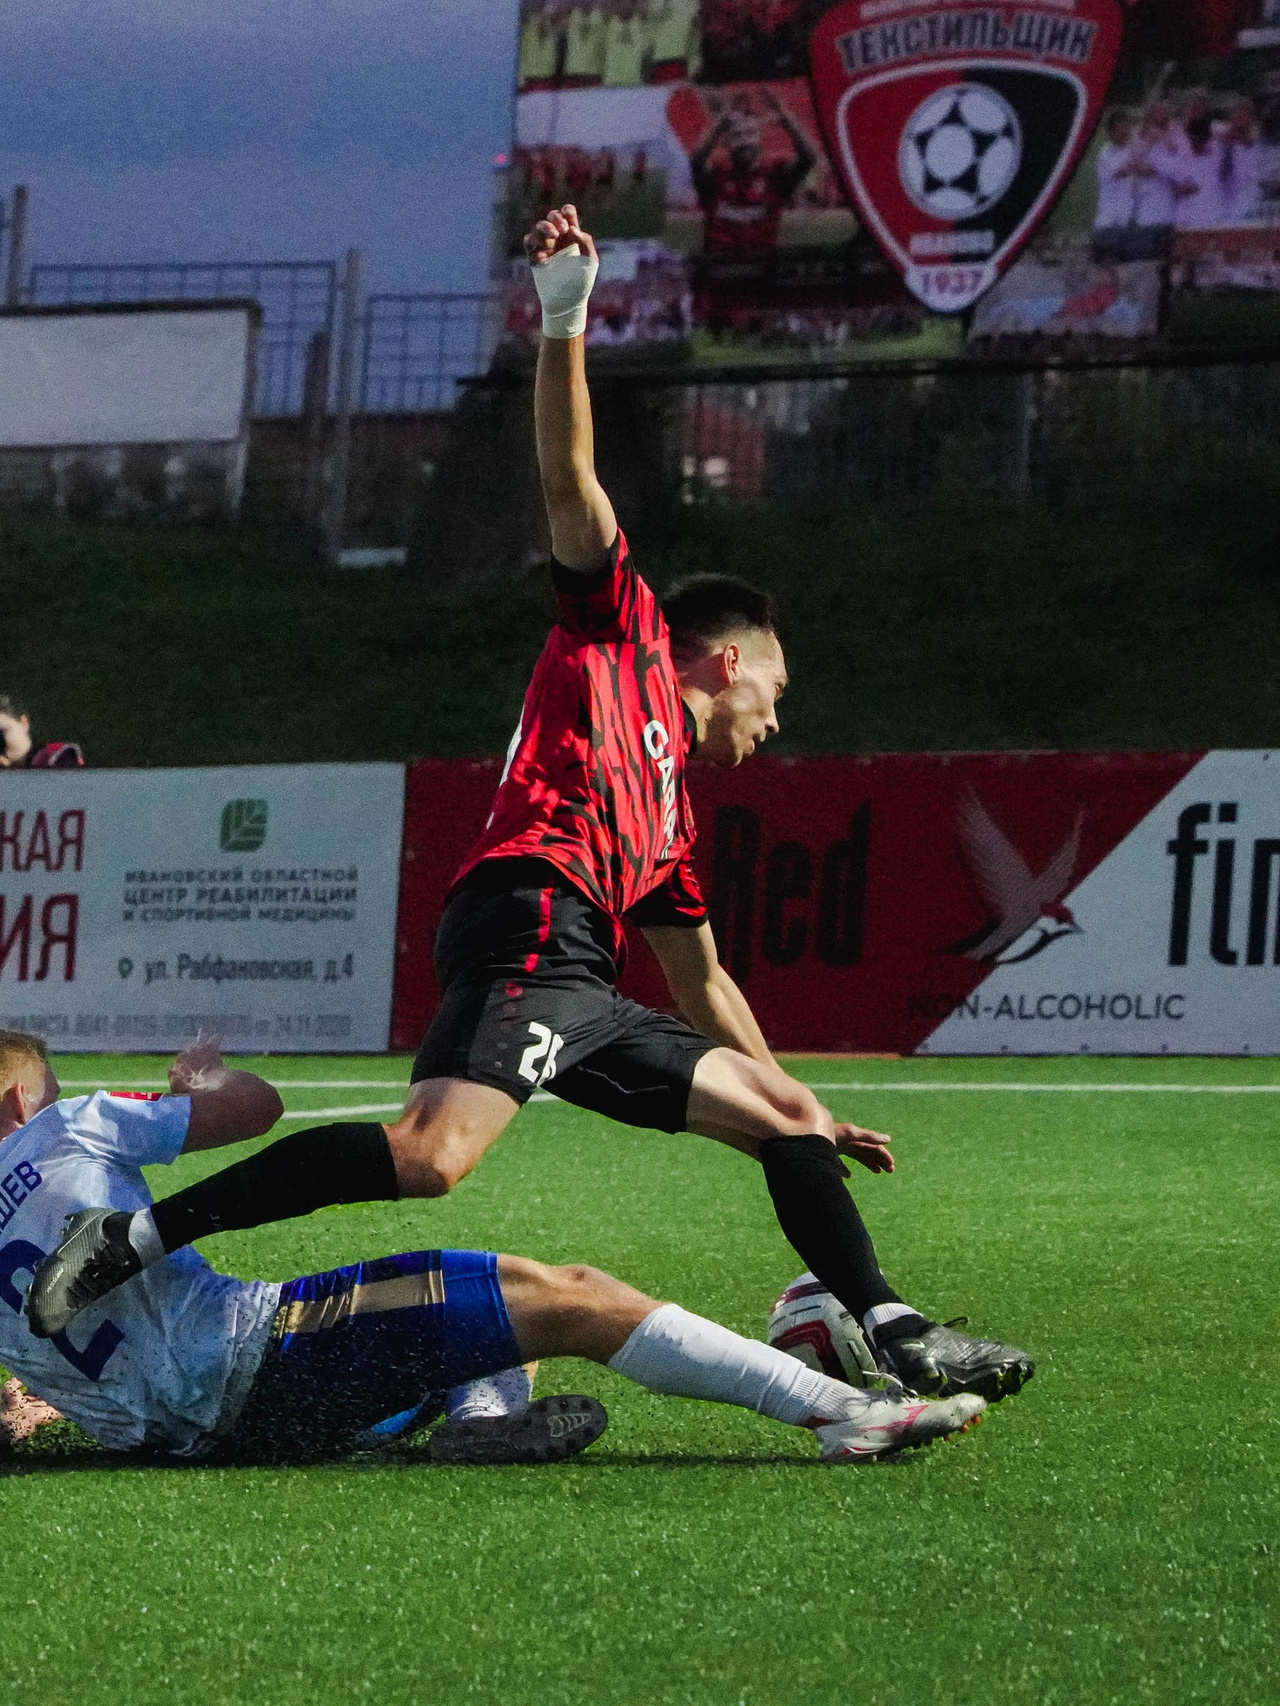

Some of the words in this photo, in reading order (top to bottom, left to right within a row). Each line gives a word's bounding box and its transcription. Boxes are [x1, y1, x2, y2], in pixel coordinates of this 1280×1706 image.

[836, 9, 1098, 73] ТЕКСТИЛЬЩИК
[921, 269, 982, 295] 1937
[124, 866, 244, 884] ИВАНОВСКИЙ
[250, 865, 359, 883] ОБЛАСТНОЙ
[123, 887, 188, 905] ЦЕНТР
[195, 886, 358, 904] РЕАБИЛИТАЦИИ
[713, 801, 871, 983] Red
[122, 909, 134, 921] И
[140, 907, 251, 922] СПОРТИВНОЙ
[258, 908, 357, 923] МЕДИЦИНЫ
[909, 994, 1185, 1022] NON-ALCOHOLIC
